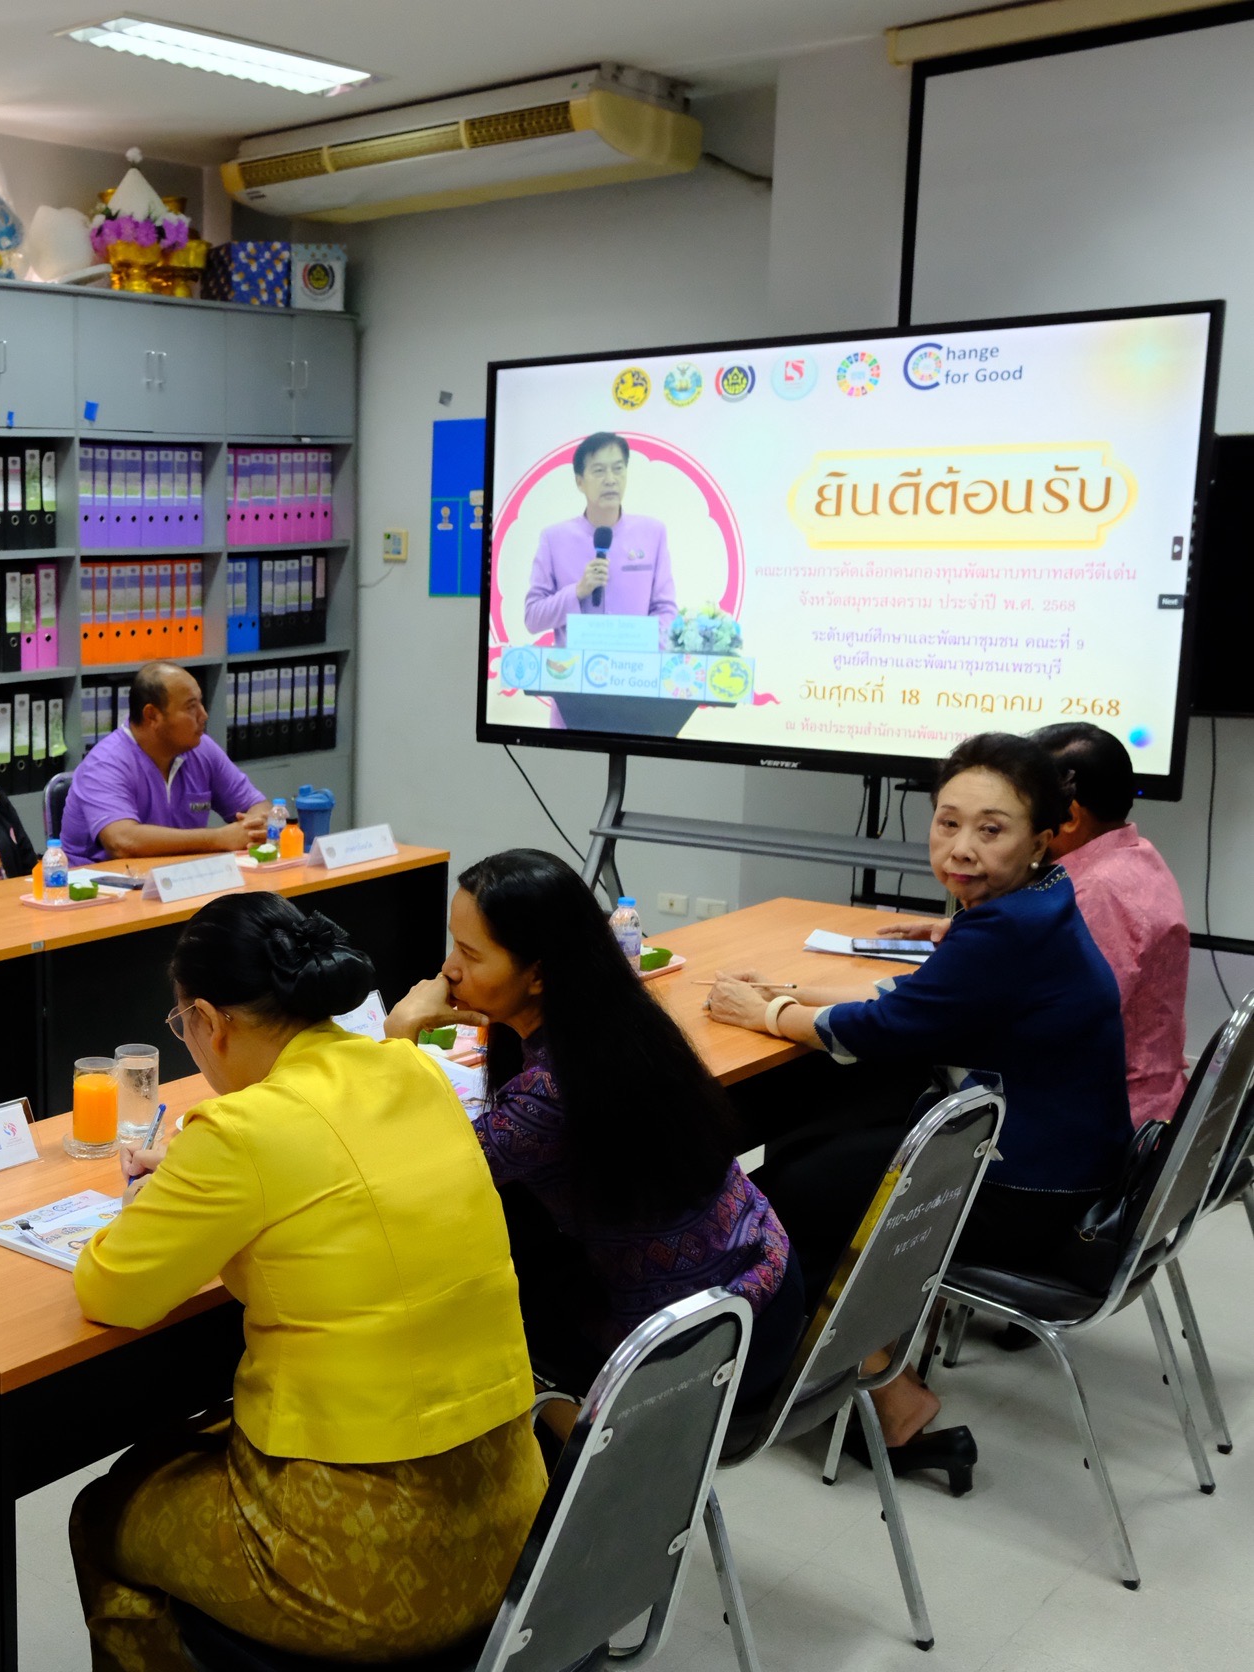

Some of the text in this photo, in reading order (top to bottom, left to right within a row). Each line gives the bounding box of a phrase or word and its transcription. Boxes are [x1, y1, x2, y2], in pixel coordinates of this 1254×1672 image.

[944, 366, 1023, 385] for Good
[814, 464, 1112, 517] ยินดีต้อนรับ
[798, 590, 1077, 613] จังหวัดสมุทรสงคราม ประจำปี พ.ศ. 2568
[811, 626, 1085, 654] ระดับศูนย์ศึกษาและพัฒนาชุมชน คณะที่ 9
[833, 650, 1063, 681] ศูนย์ศึกษาและพัฒนาชุมชนเพชรบุรี
[609, 676, 659, 689] for Good
[798, 675, 1122, 717] วันศุกร์ที่ 18 กรกฎาคม 2568
[759, 759, 800, 768] VERTEX
